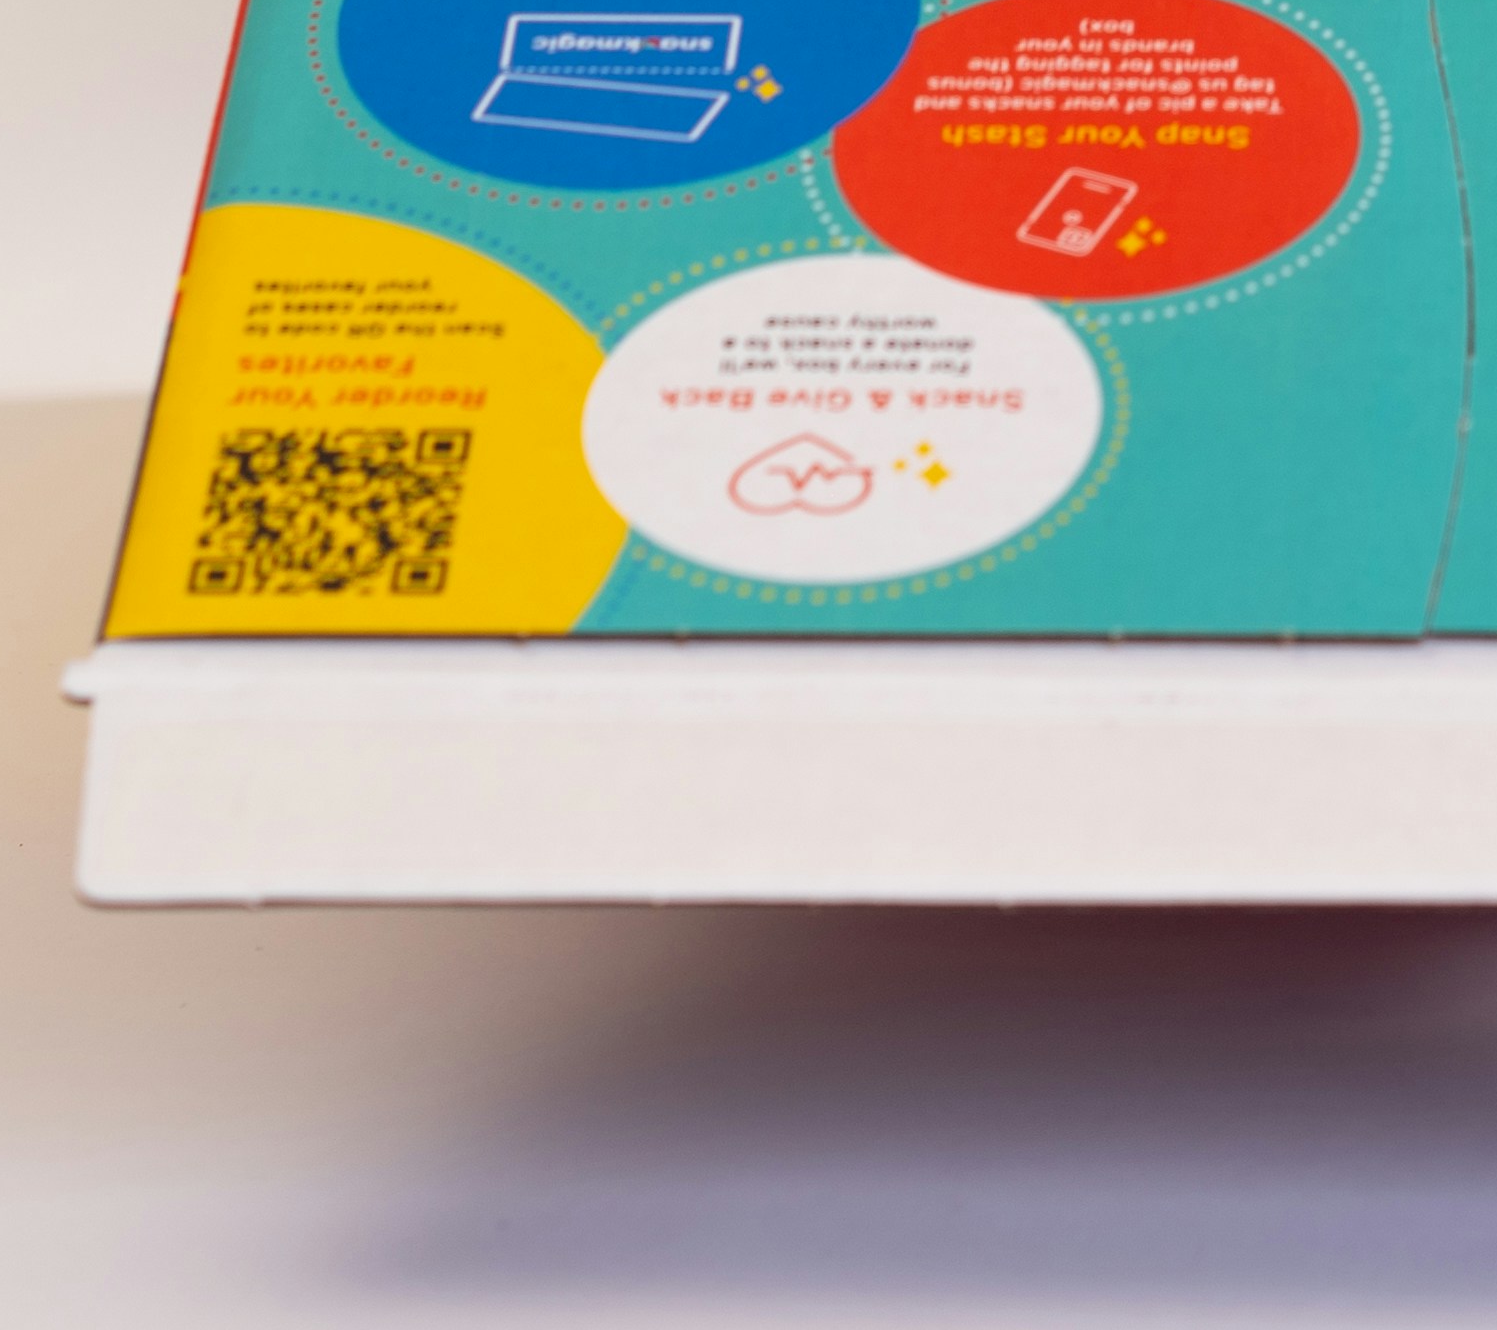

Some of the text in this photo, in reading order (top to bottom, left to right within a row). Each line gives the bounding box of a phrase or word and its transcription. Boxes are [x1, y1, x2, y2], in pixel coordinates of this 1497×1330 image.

[1079, 18, 1136, 37] box)
[1014, 35, 1196, 55] brands in your
[967, 55, 1239, 75] points for tagging the
[926, 74, 1276, 96] tag us @snackmagic (bonus
[913, 94, 1284, 115] Take pic of your snacks and
[941, 122, 1251, 150] Snap Your Stash
[253, 277, 431, 296] your favorites
[281, 301, 459, 317] reorder cases
[277, 323, 341, 338] code
[394, 322, 437, 339] the
[444, 322, 506, 339] Scan
[764, 312, 939, 331] worthy cause
[779, 337, 975, 352] donate snack
[237, 353, 417, 378] Favorites
[846, 355, 972, 376] For every
[227, 384, 489, 412] Reorder Your
[659, 387, 1026, 414] Snack & Give Back
